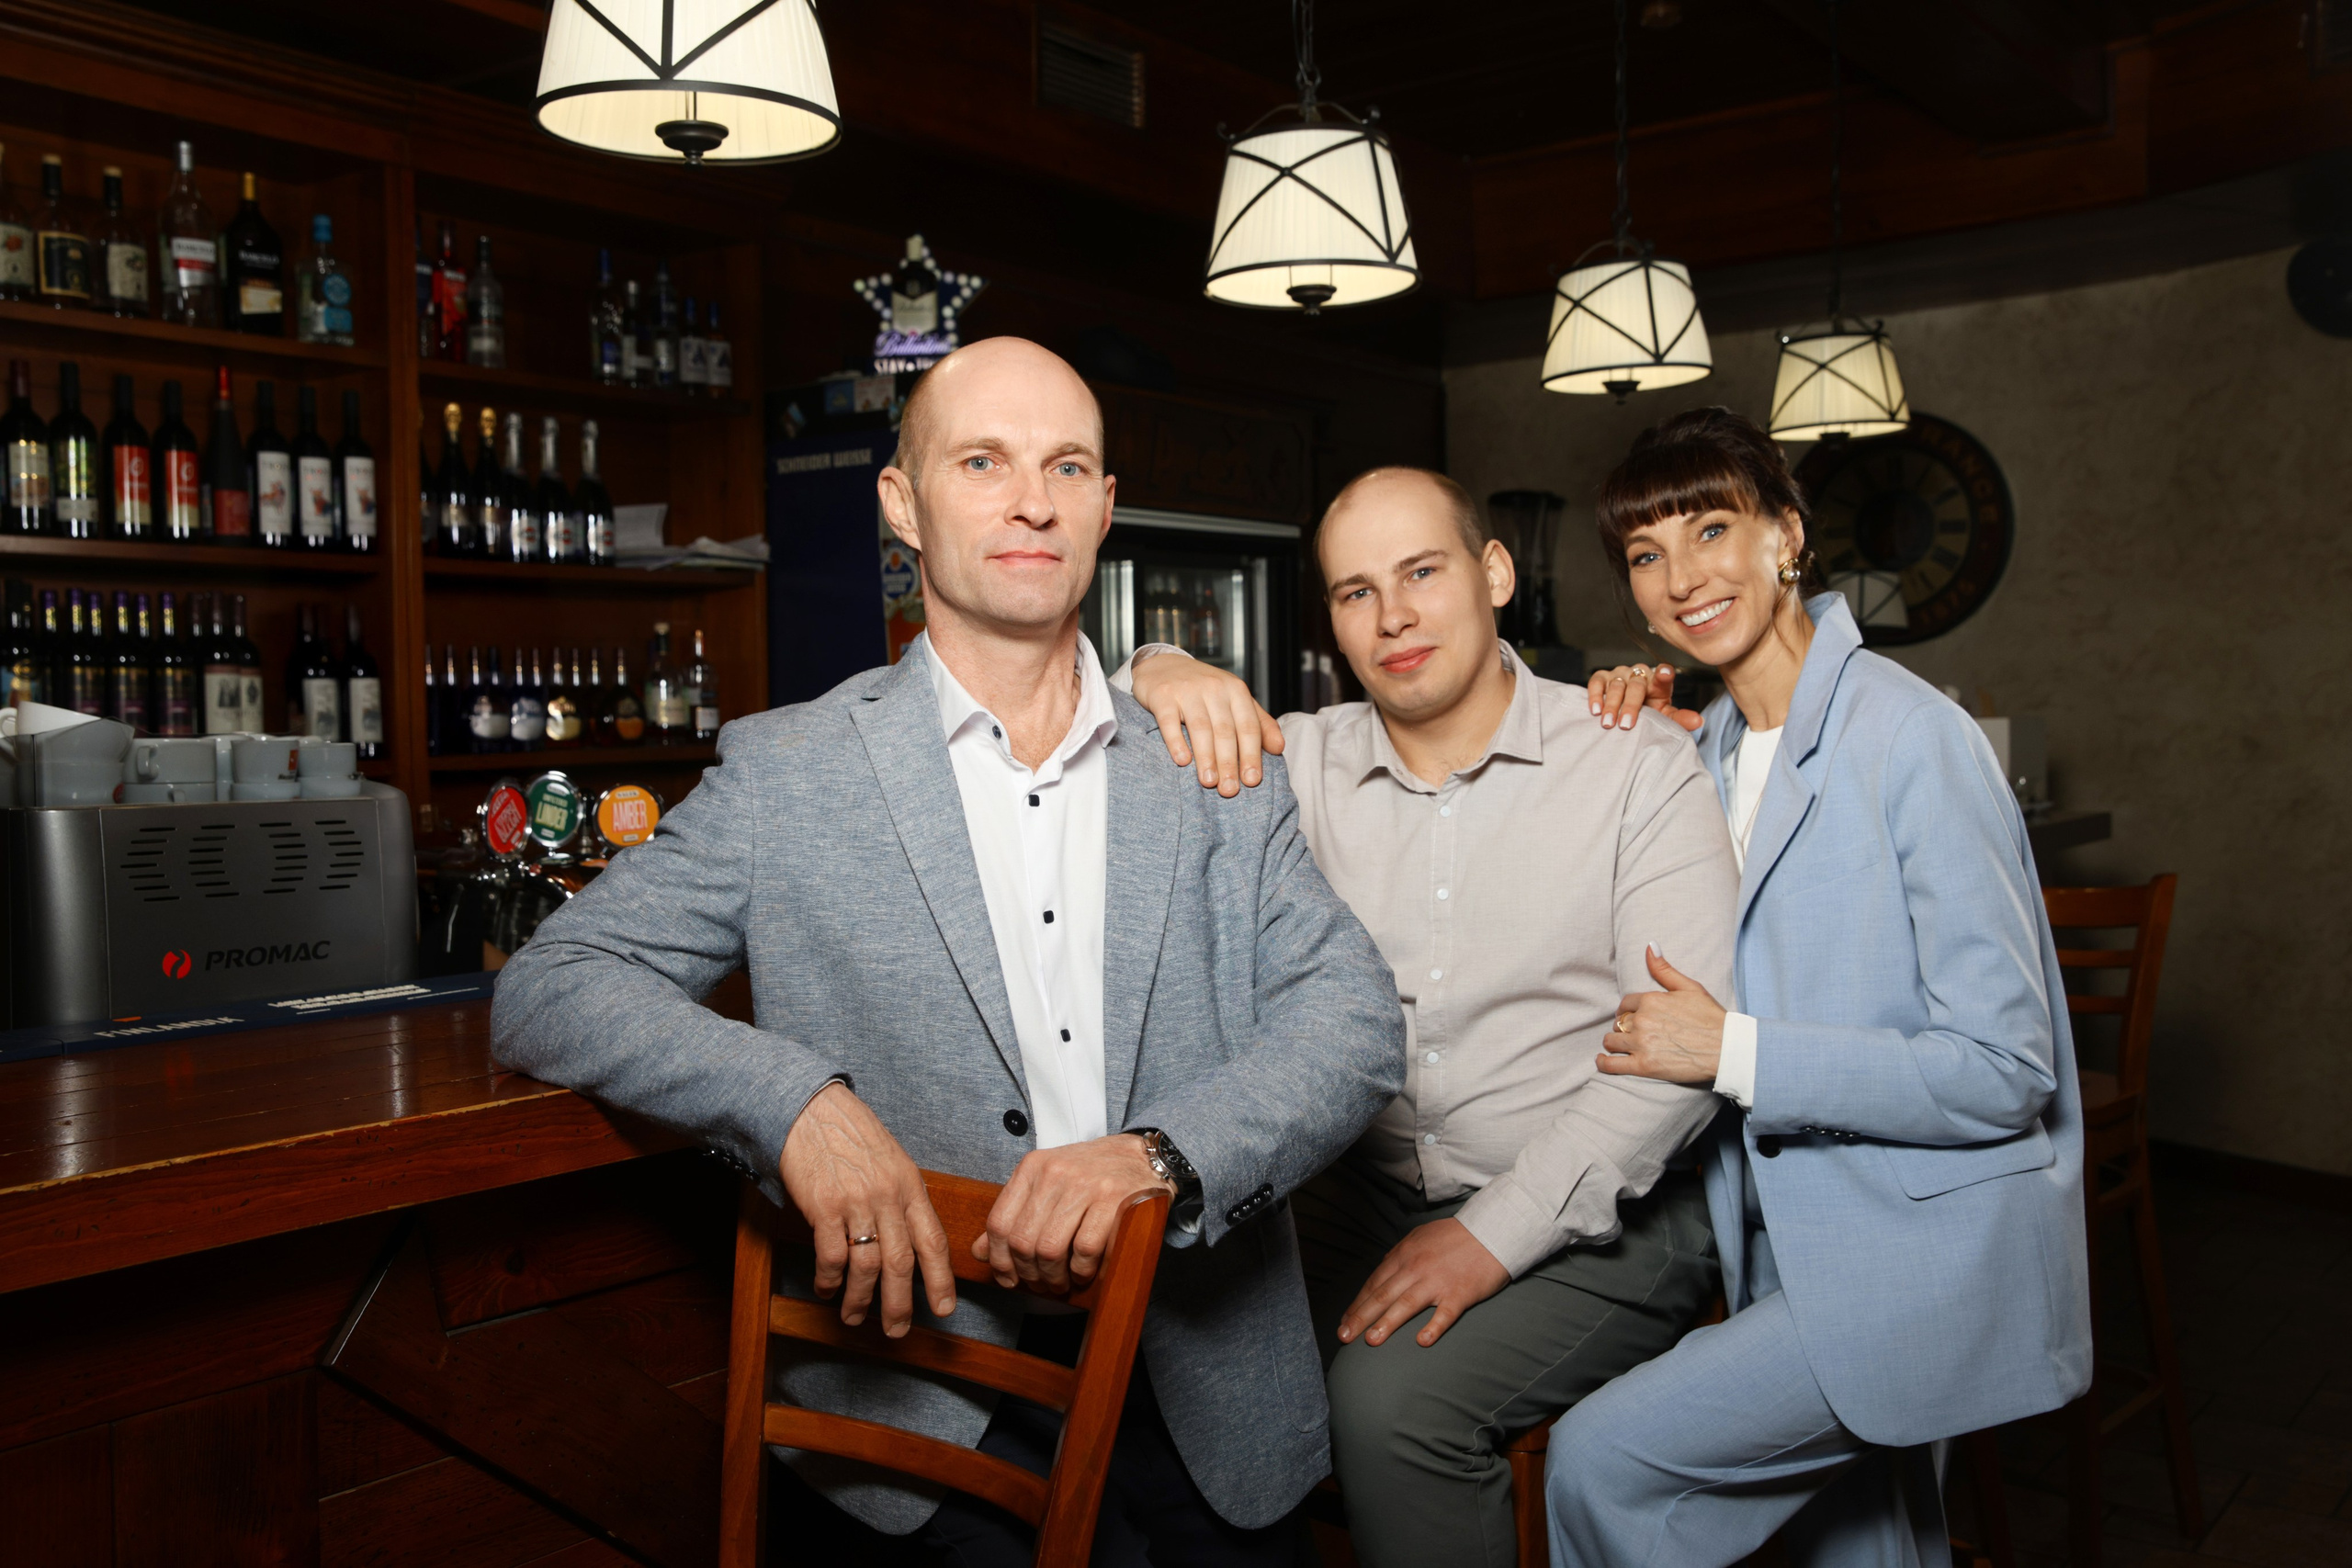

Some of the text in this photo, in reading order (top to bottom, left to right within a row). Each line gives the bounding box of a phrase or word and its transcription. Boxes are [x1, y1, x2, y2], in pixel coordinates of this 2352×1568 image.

[612, 798, 648, 833] AMBER
[205, 940, 331, 972] PROMAC
[94, 1015, 244, 1038] FINLANDIA
